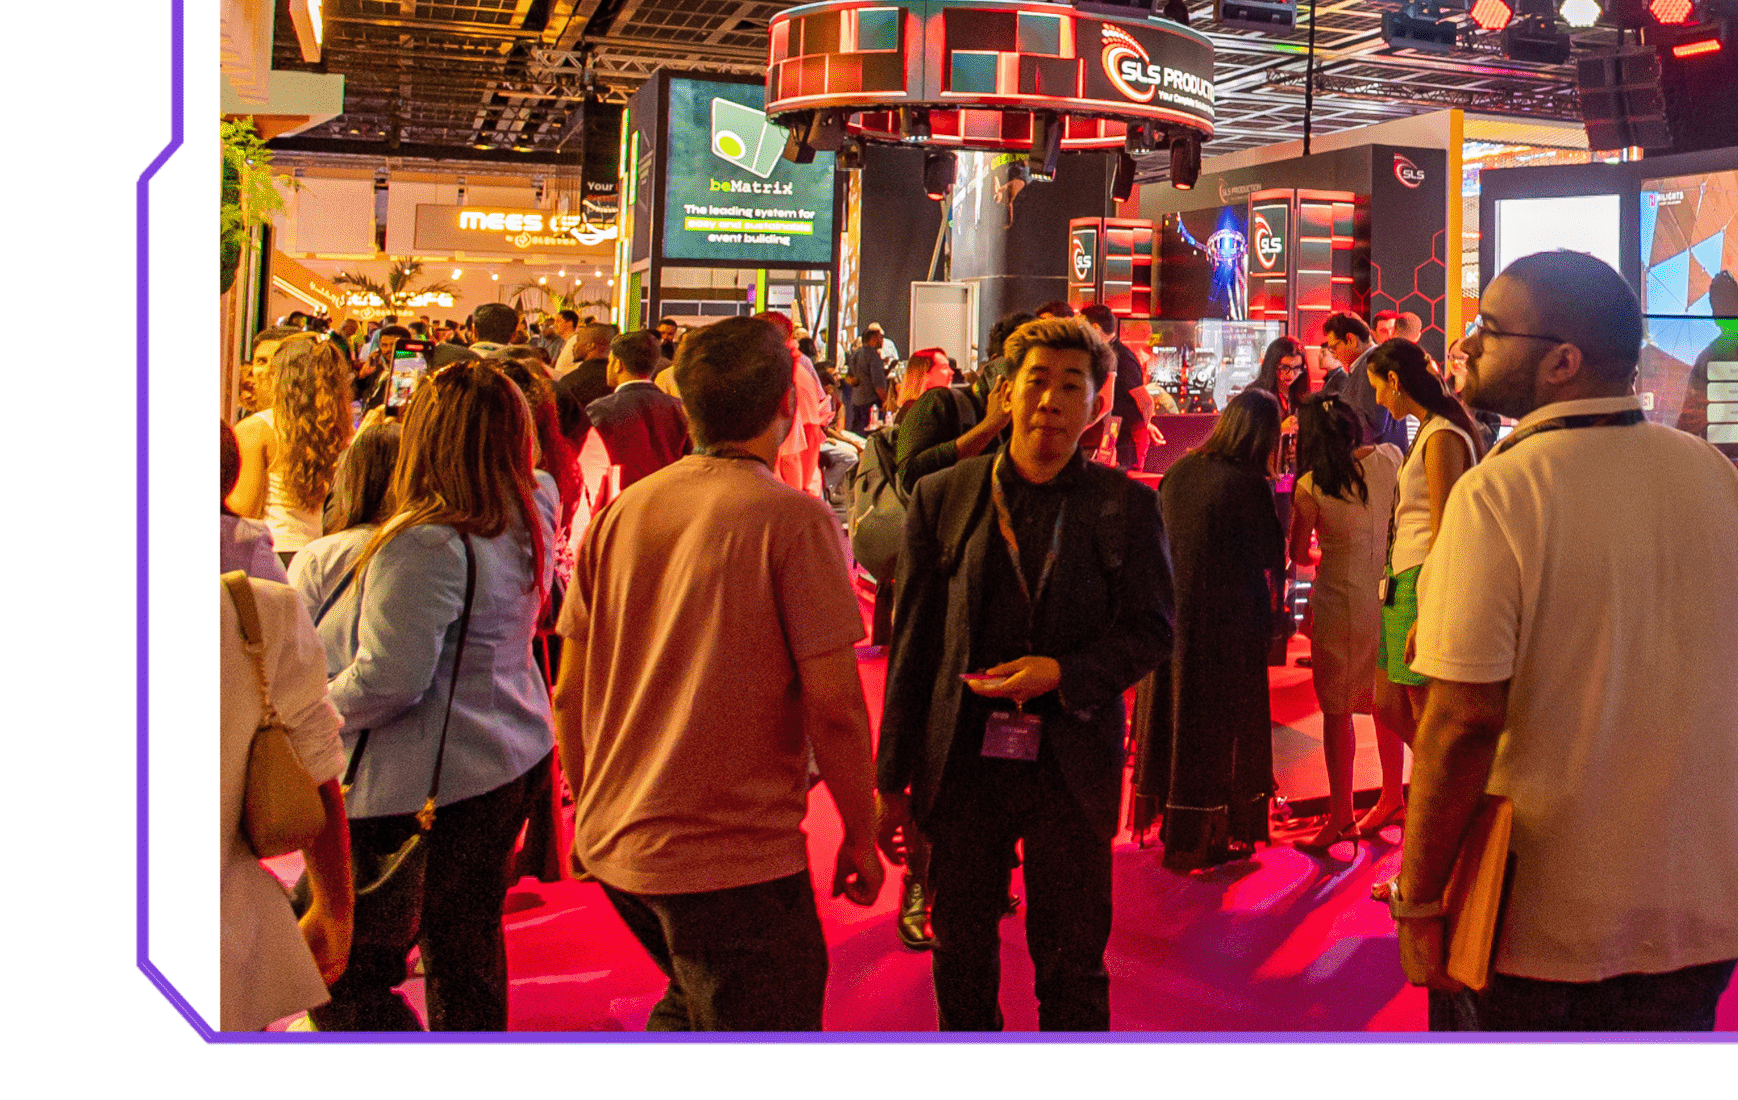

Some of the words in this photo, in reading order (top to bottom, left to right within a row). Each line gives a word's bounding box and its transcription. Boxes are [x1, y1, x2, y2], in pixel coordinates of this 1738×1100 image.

[1121, 61, 1161, 85] SLS
[1403, 169, 1425, 180] SLS
[587, 181, 614, 191] Your
[709, 178, 793, 195] beMatrix
[683, 204, 707, 215] The
[708, 205, 753, 218] leading
[754, 208, 797, 219] system
[798, 209, 815, 219] for
[687, 219, 716, 229] easy
[717, 220, 742, 229] and
[743, 221, 811, 232] sustainable
[707, 233, 742, 243] event
[743, 233, 790, 247] building
[1261, 237, 1282, 254] SLS
